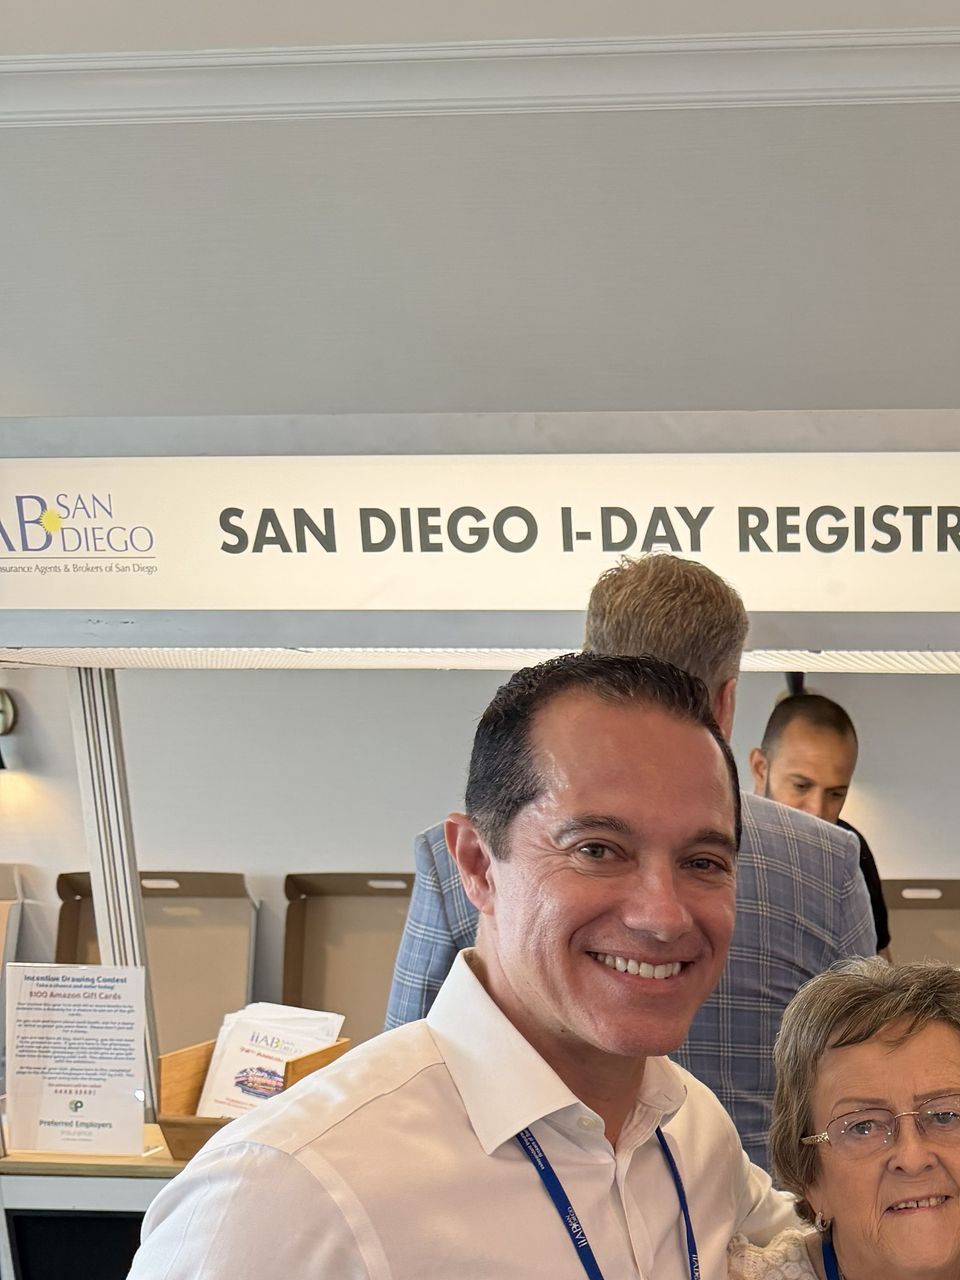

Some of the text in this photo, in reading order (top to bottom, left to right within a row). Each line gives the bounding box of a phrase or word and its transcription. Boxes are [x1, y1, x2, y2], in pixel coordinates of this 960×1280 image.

[56, 493, 113, 520] SAN
[60, 526, 154, 552] DIEGO
[219, 507, 338, 554] SAN
[360, 505, 538, 553] DIEGO
[561, 506, 715, 552] I-DAY
[34, 564, 61, 576] Agents
[63, 564, 70, 573] &
[72, 563, 104, 573] Brokers
[105, 562, 114, 573] of
[115, 564, 131, 573] San
[133, 563, 158, 576] Diego
[96, 975, 127, 984] Contest
[49, 991, 81, 999] Amazon
[82, 991, 97, 999] Gift
[98, 992, 122, 1000] Cards
